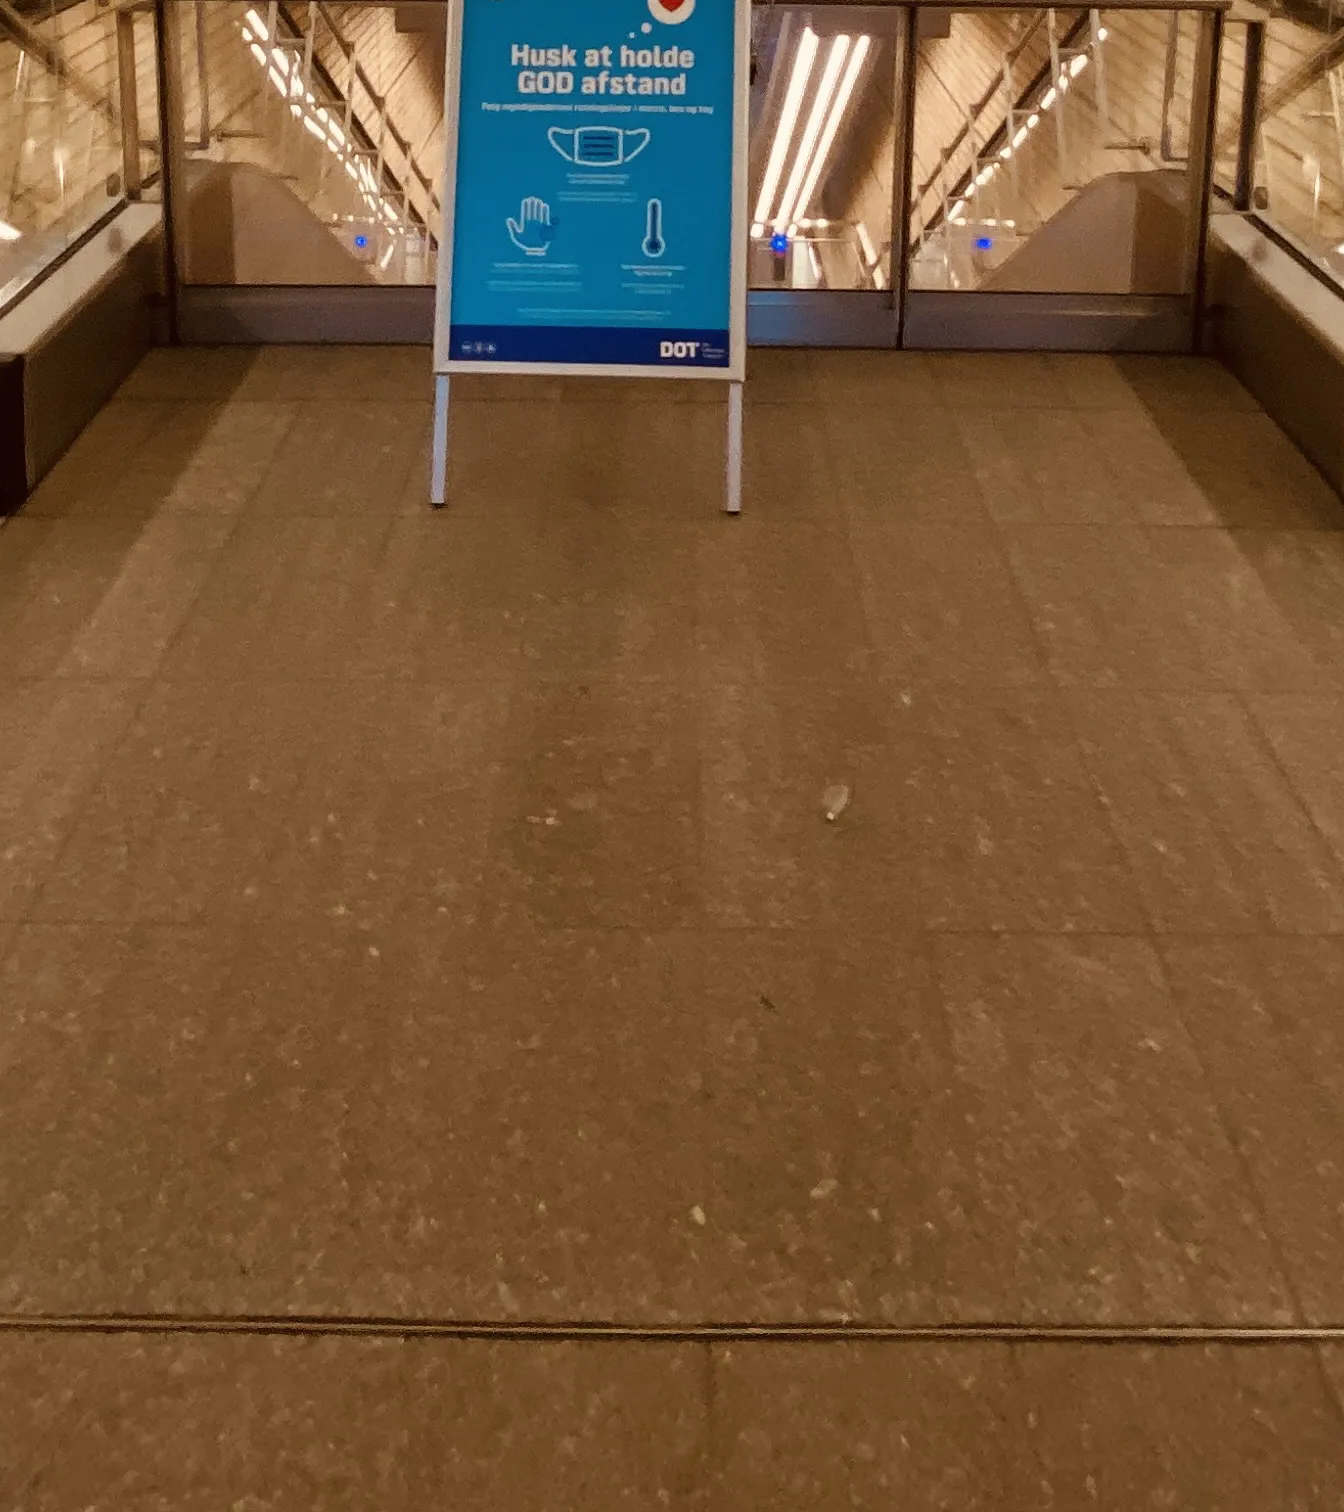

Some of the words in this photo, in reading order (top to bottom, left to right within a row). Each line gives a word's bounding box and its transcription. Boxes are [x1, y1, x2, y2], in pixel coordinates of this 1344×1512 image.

[511, 44, 577, 67] Husk
[584, 45, 613, 67] at
[620, 45, 695, 68] holde
[518, 71, 574, 94] GOD
[581, 71, 687, 96] afstand
[659, 341, 700, 358] DOT
